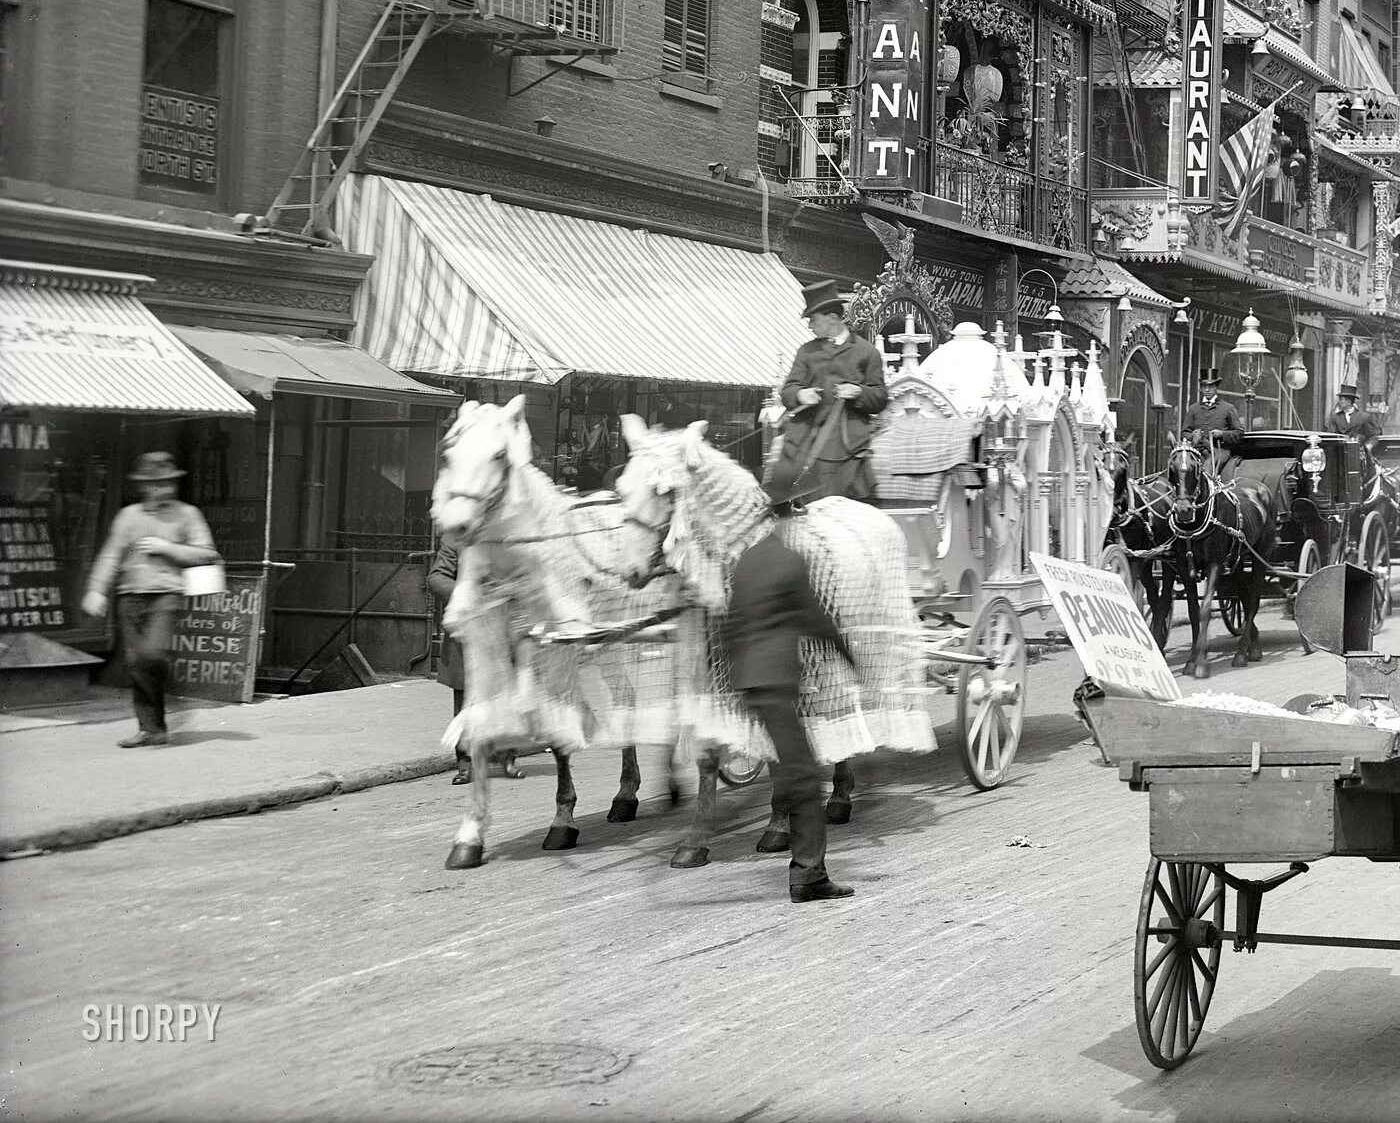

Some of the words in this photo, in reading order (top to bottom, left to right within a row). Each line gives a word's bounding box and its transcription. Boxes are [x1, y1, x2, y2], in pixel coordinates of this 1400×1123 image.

[1261, 59, 1288, 79] PORT
[932, 264, 956, 279] WING
[959, 270, 984, 284] TONG
[948, 280, 985, 309] JAPAN
[1018, 294, 1052, 319] VELTIES
[1208, 312, 1240, 337] KEE
[1060, 590, 1153, 652] PEANUTS
[171, 635, 241, 655] INESE
[174, 659, 247, 684] CERIES
